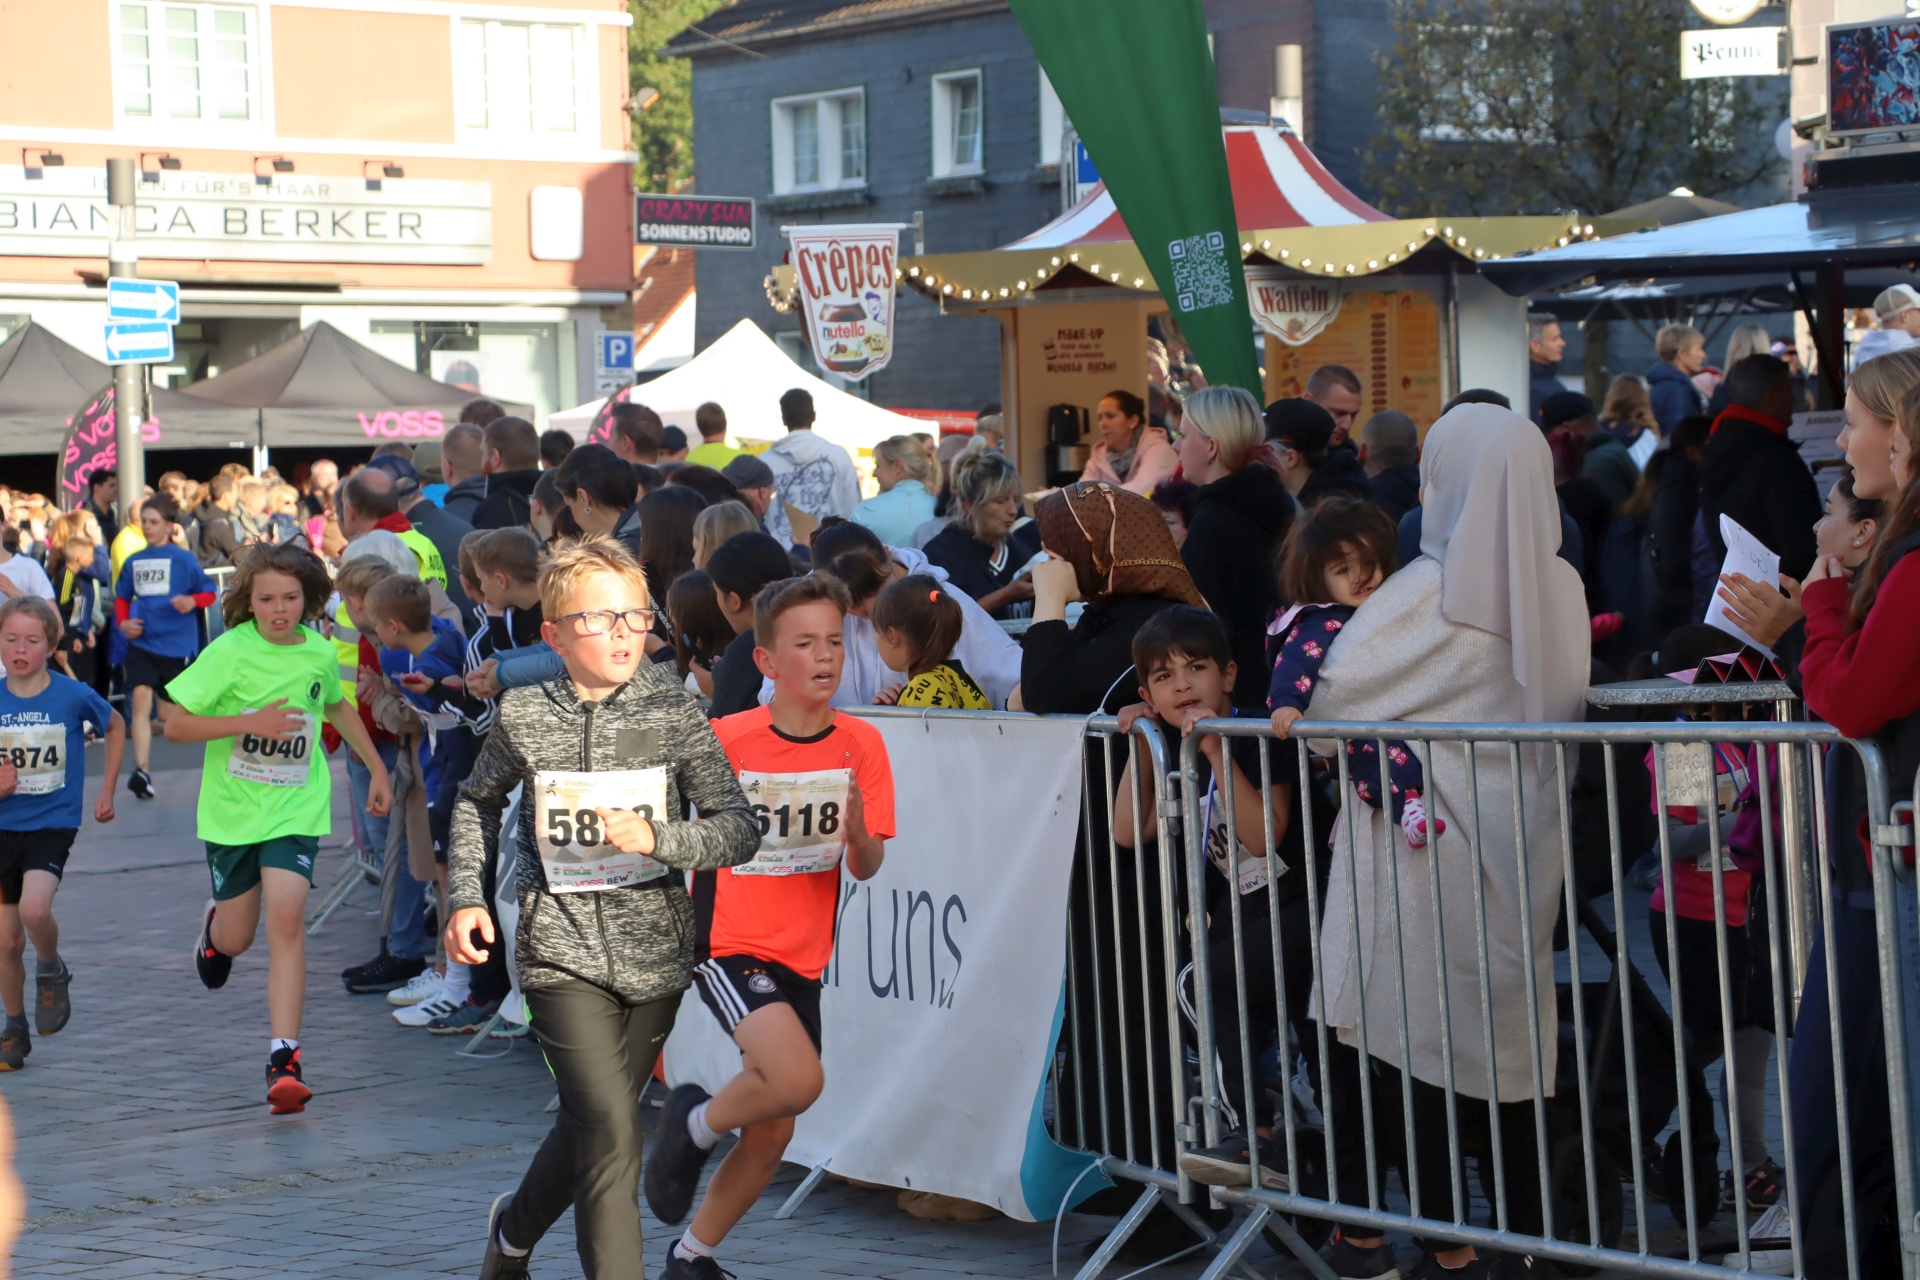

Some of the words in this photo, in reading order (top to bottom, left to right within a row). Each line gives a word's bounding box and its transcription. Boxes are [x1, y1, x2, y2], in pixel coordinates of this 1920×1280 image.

[93, 174, 166, 192] IEN
[223, 207, 422, 239] BERKER
[640, 199, 708, 221] CRAZY
[711, 202, 751, 224] SUN
[640, 223, 751, 244] SONNENSTUDIO
[798, 238, 893, 300] Crêpes
[1258, 285, 1329, 314] Waffeln
[822, 321, 865, 340] nutella
[610, 338, 627, 365] P
[357, 409, 445, 439] VOSS
[135, 569, 165, 583] 5973
[1, 712, 50, 725] ST.-ANGELA
[242, 733, 306, 759] 6040
[750, 801, 839, 837] 6118
[574, 878, 604, 887] VOSS
[606, 874, 629, 885] BEW
[794, 864, 813, 872] BEW
